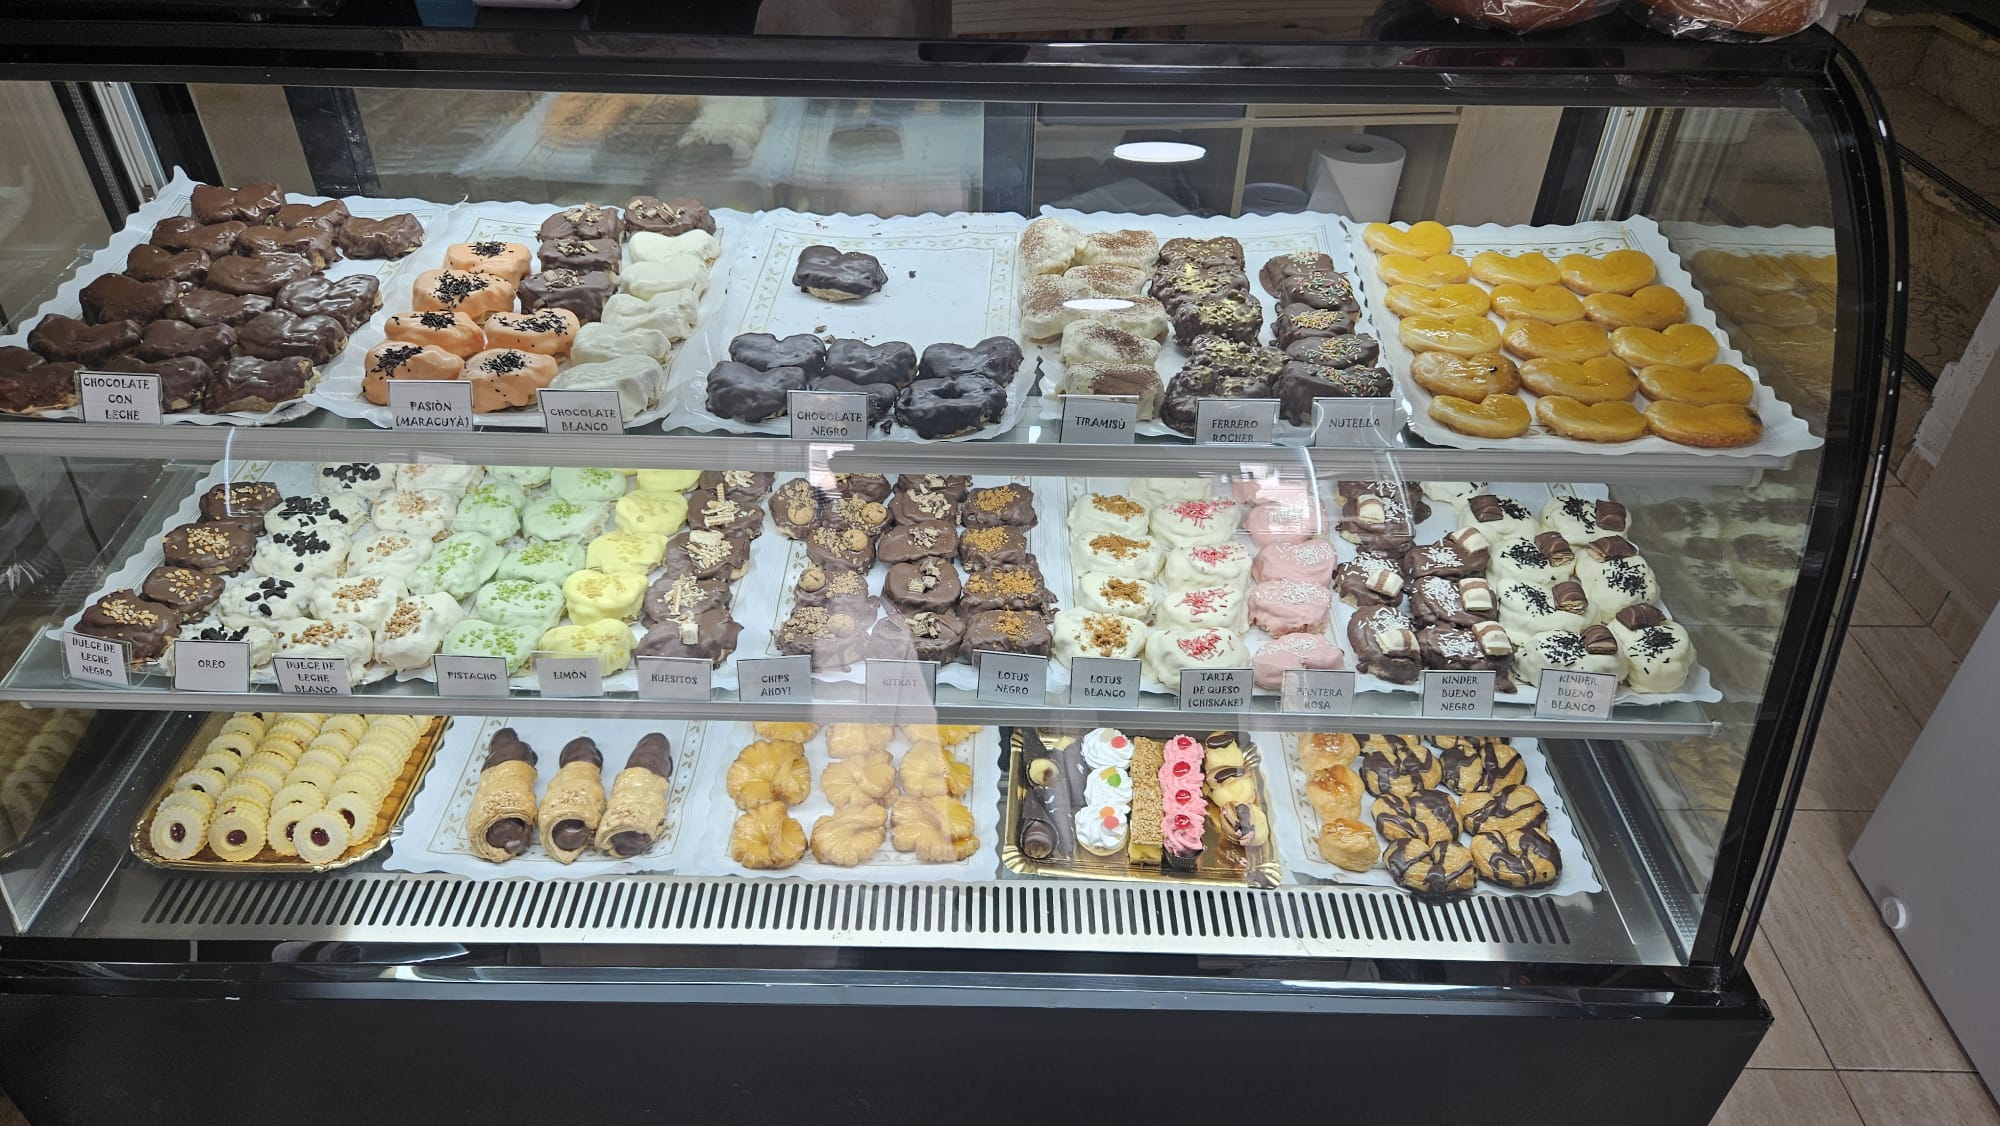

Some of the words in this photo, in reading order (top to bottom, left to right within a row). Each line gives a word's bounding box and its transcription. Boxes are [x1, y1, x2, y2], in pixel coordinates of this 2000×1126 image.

[83, 377, 150, 390] CHOCOLATE
[108, 394, 132, 404] CON
[105, 409, 140, 421] LECHE
[550, 408, 617, 419] CHOCOLATE
[797, 411, 863, 423] CHOCOLATE
[561, 421, 609, 432] BLANCO
[1212, 418, 1259, 429] FERRERO
[1328, 418, 1380, 428] NUTELLA
[810, 426, 848, 436] NEGRO
[1212, 433, 1254, 443] ROCHER
[72, 637, 102, 651] DULCE
[103, 643, 116, 654] DE
[81, 651, 110, 665] LECHE
[197, 659, 226, 669] OREO
[286, 660, 321, 670] DULCE
[322, 661, 336, 671] DE
[82, 664, 112, 677] NEGRO
[447, 671, 498, 681] PISTACHO
[998, 670, 1030, 682] LOTUS
[297, 673, 330, 682] LECHE
[651, 673, 698, 685] HUESITOS
[761, 673, 790, 683] CHIPS
[1090, 674, 1122, 685] LOTUS
[1200, 672, 1234, 681] TARTA
[1441, 675, 1479, 685] KINDER
[1559, 674, 1597, 687] KINDER
[294, 684, 338, 694] BLANCO
[760, 686, 792, 697] AHOY!
[995, 683, 1029, 695] NEGRO
[1084, 687, 1126, 698] BLANCO
[1193, 685, 1206, 695] DE
[1207, 685, 1240, 695] QUESO
[1441, 688, 1477, 698] BUENO
[1557, 687, 1594, 699] BUENO
[1188, 697, 1244, 708] (CHISKAKE)
[1304, 700, 1331, 710] ROSA
[1440, 702, 1475, 711] NEGRO
[1551, 700, 1596, 713] BLANCO
